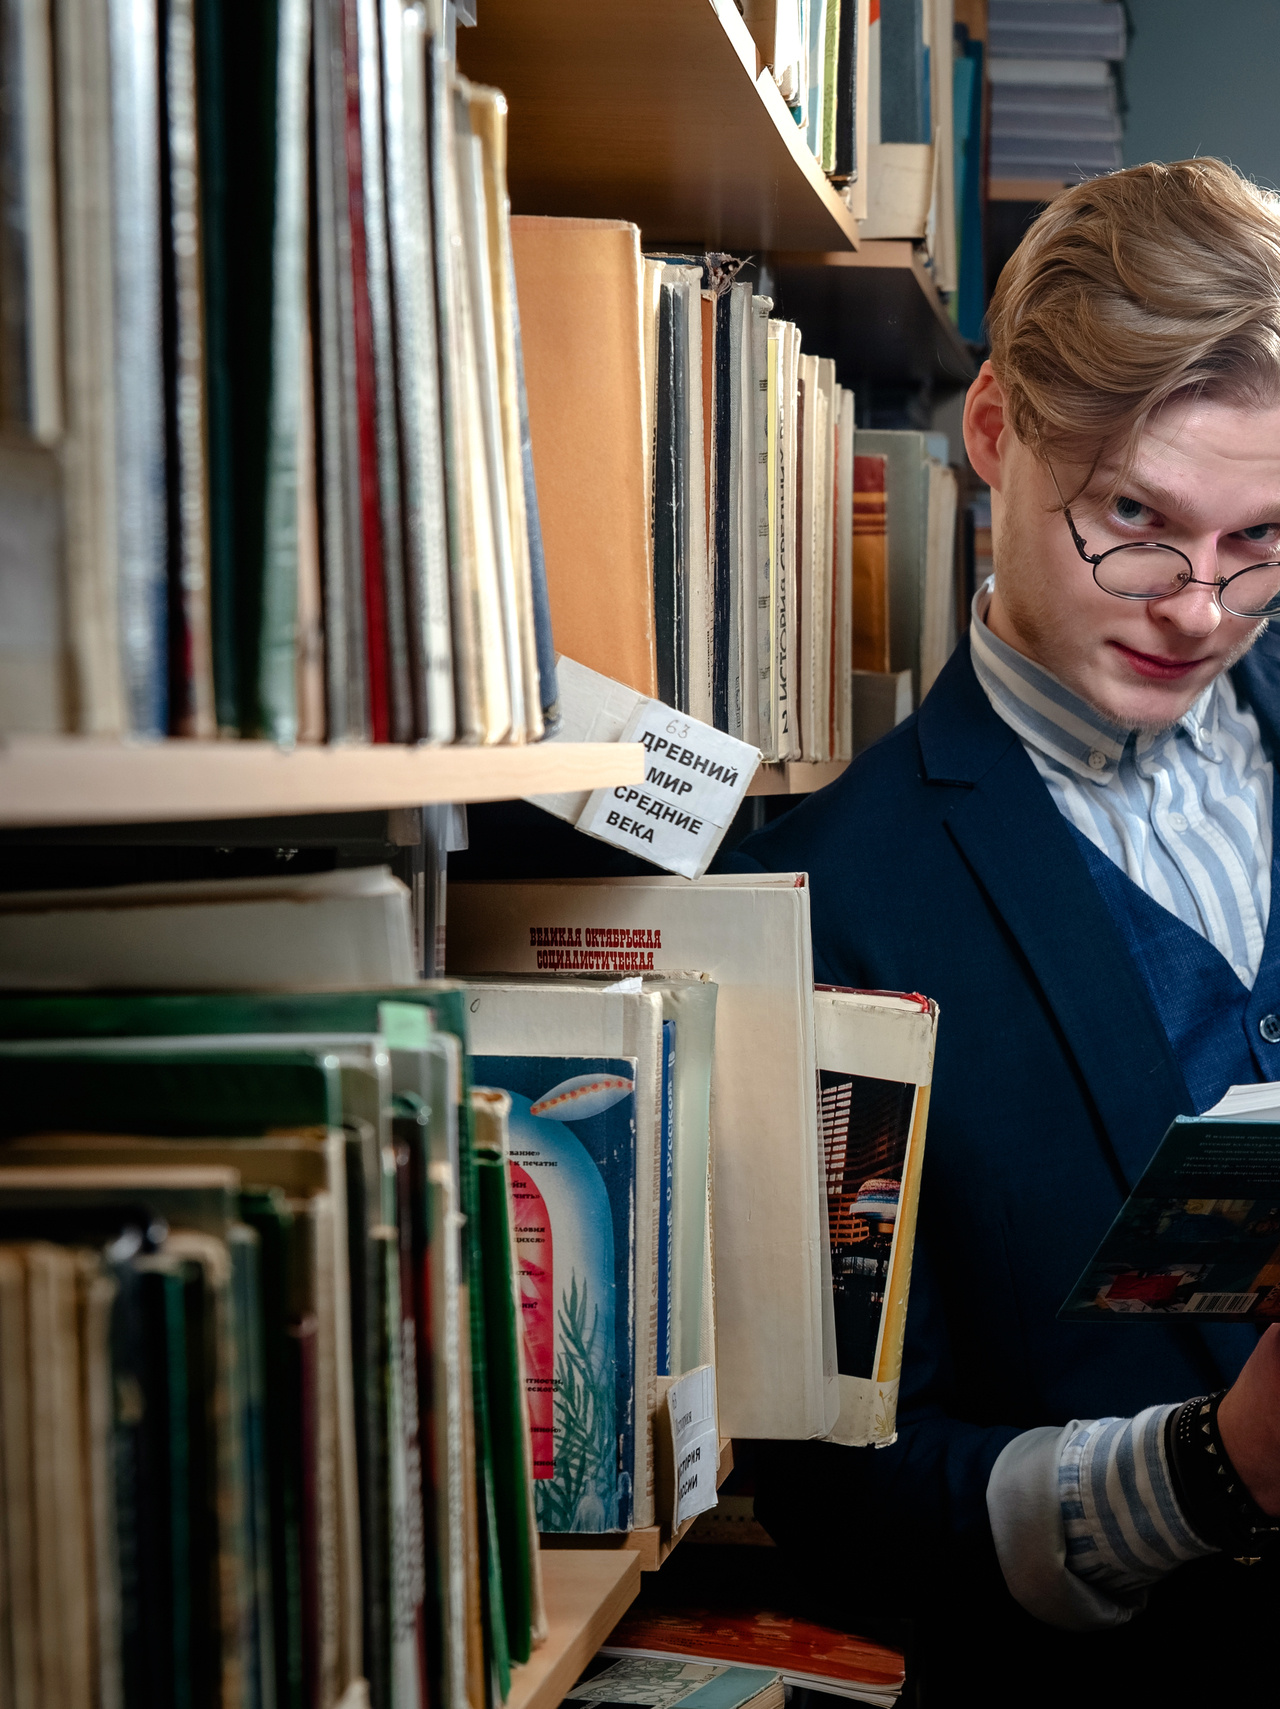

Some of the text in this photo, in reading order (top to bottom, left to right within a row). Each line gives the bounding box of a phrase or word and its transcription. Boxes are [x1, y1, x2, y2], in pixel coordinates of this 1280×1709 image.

[777, 577, 788, 701] ИСТОРИЯ
[638, 729, 739, 787] ДРЕВНИЙ
[646, 767, 693, 797] МИР
[614, 786, 704, 835] СРЕДНИЕ
[606, 810, 655, 844] ВЕКА
[529, 927, 662, 949] ВЕЛИКАЯ ОКТЯБРЬСКАЯ
[536, 950, 654, 971] СОЦИАЛИСТИЧЕСКАЯ
[666, 1080, 674, 1178] РУССКОЙ
[522, 1160, 558, 1168] печати:
[525, 1377, 564, 1386] тности,
[533, 1459, 557, 1467] нной
[678, 1446, 702, 1478] СТОРИЯ
